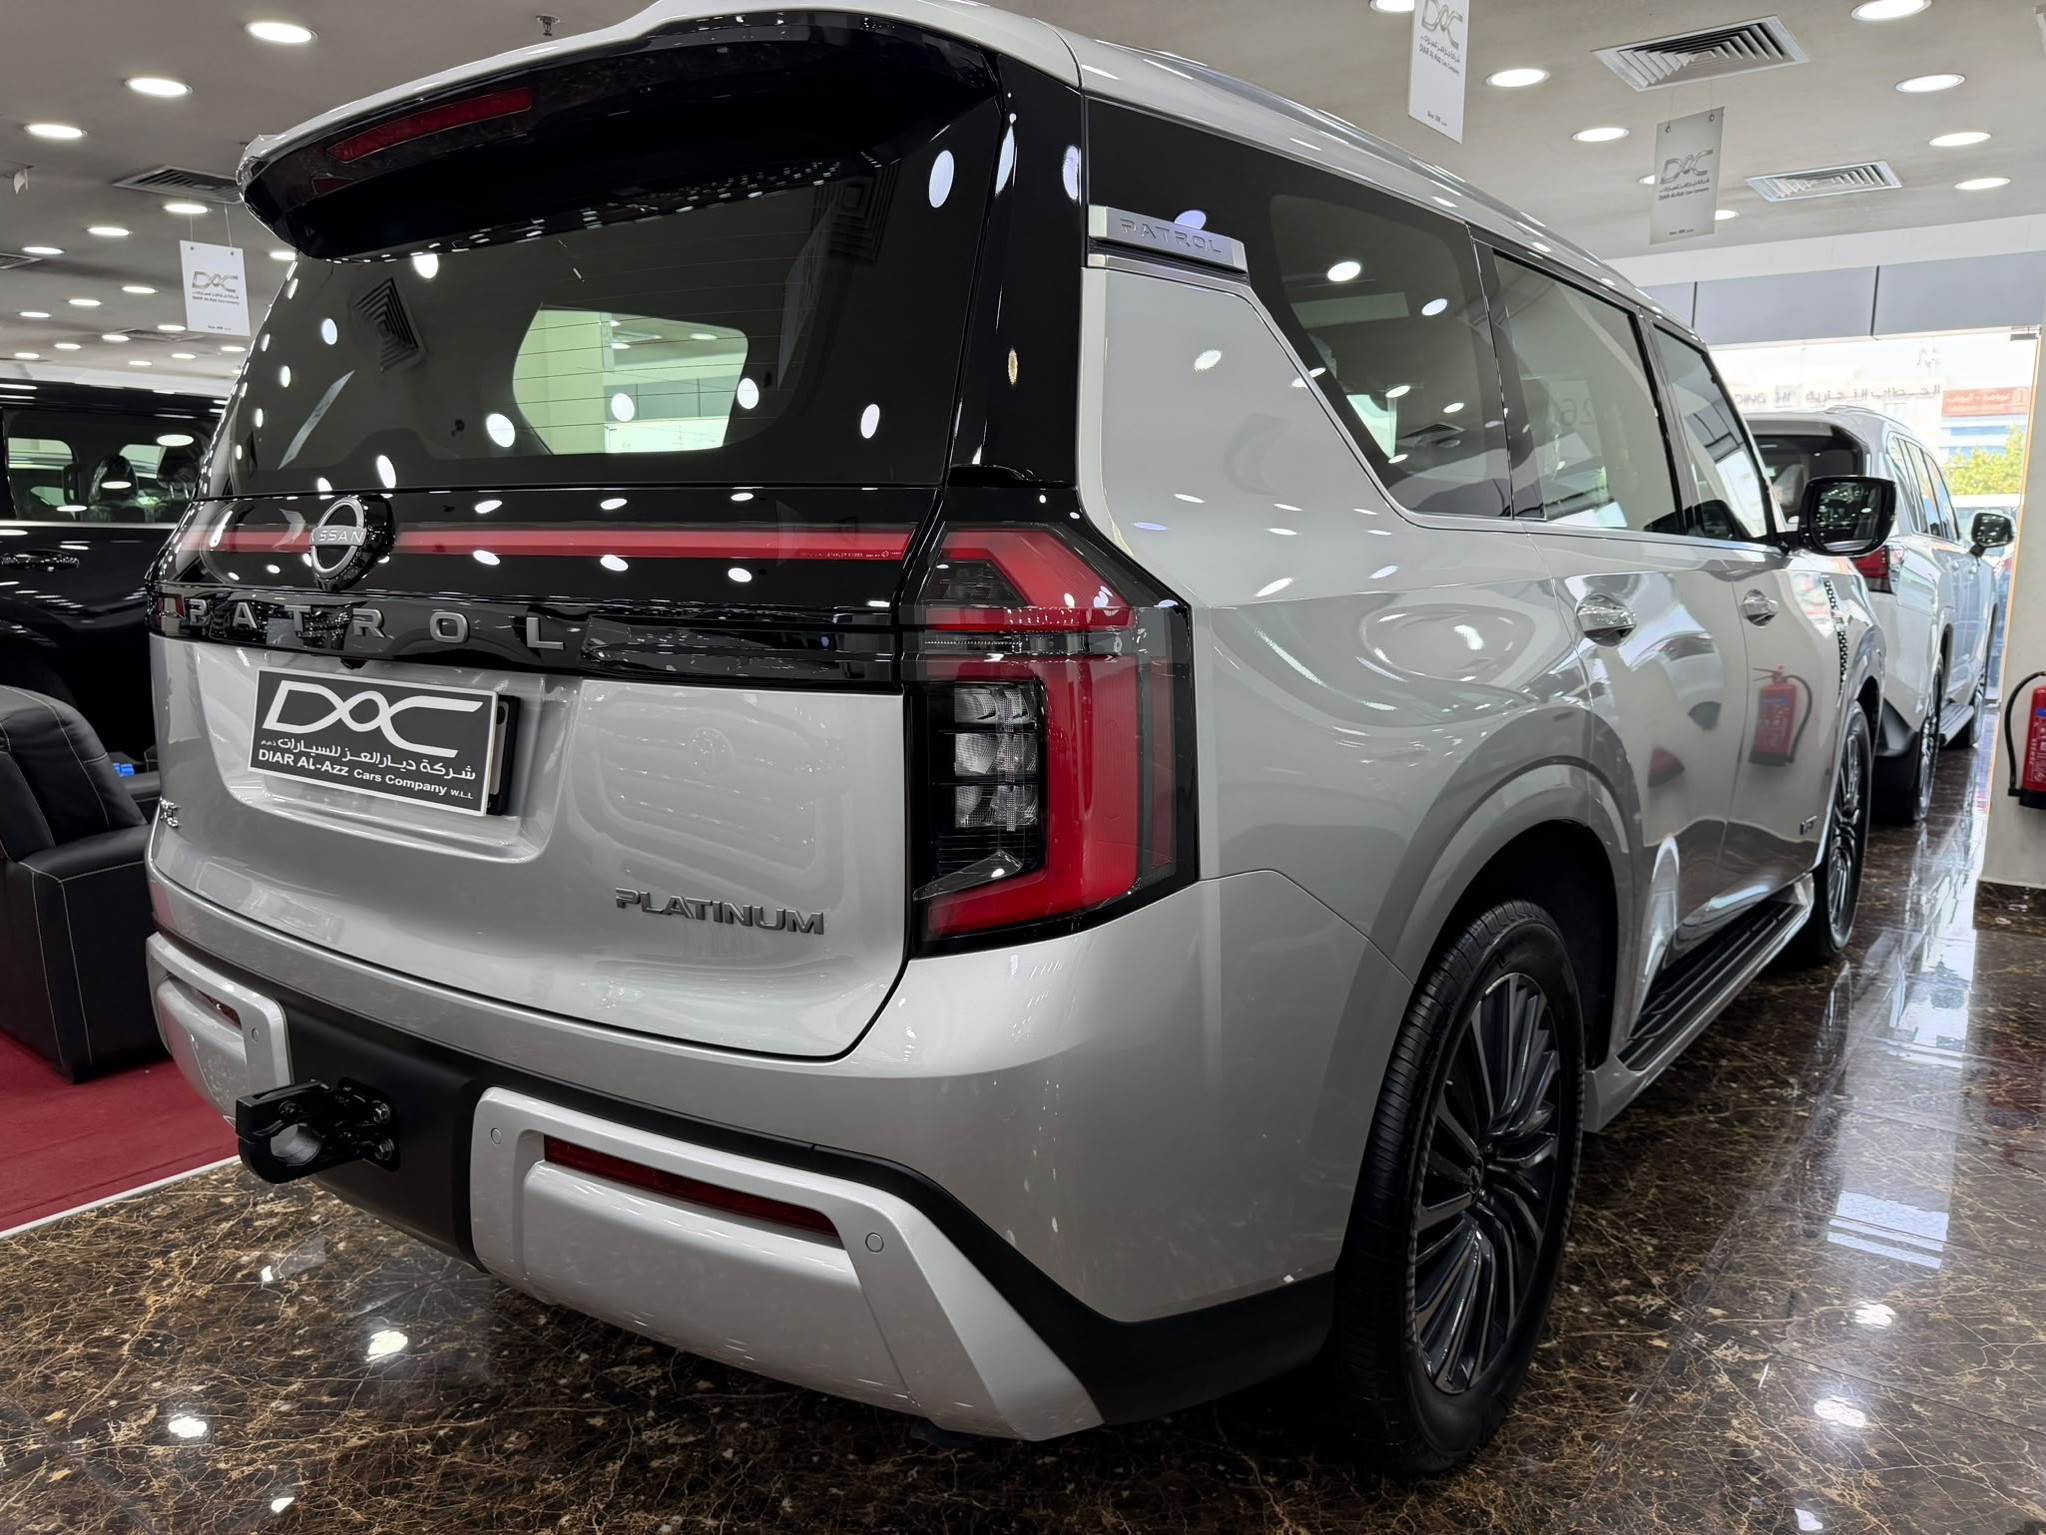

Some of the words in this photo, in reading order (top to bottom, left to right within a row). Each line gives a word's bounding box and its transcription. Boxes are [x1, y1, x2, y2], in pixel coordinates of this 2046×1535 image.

[1119, 217, 1222, 254] PATROL
[188, 597, 565, 651] PATROL
[277, 738, 341, 757] للسيارات
[341, 747, 380, 765] العز
[258, 748, 295, 767] DIAR
[353, 768, 382, 783] Cars
[385, 774, 448, 796] Company
[378, 753, 417, 773] ديار
[420, 758, 476, 780] شركة
[615, 887, 825, 936] PLATINUM
